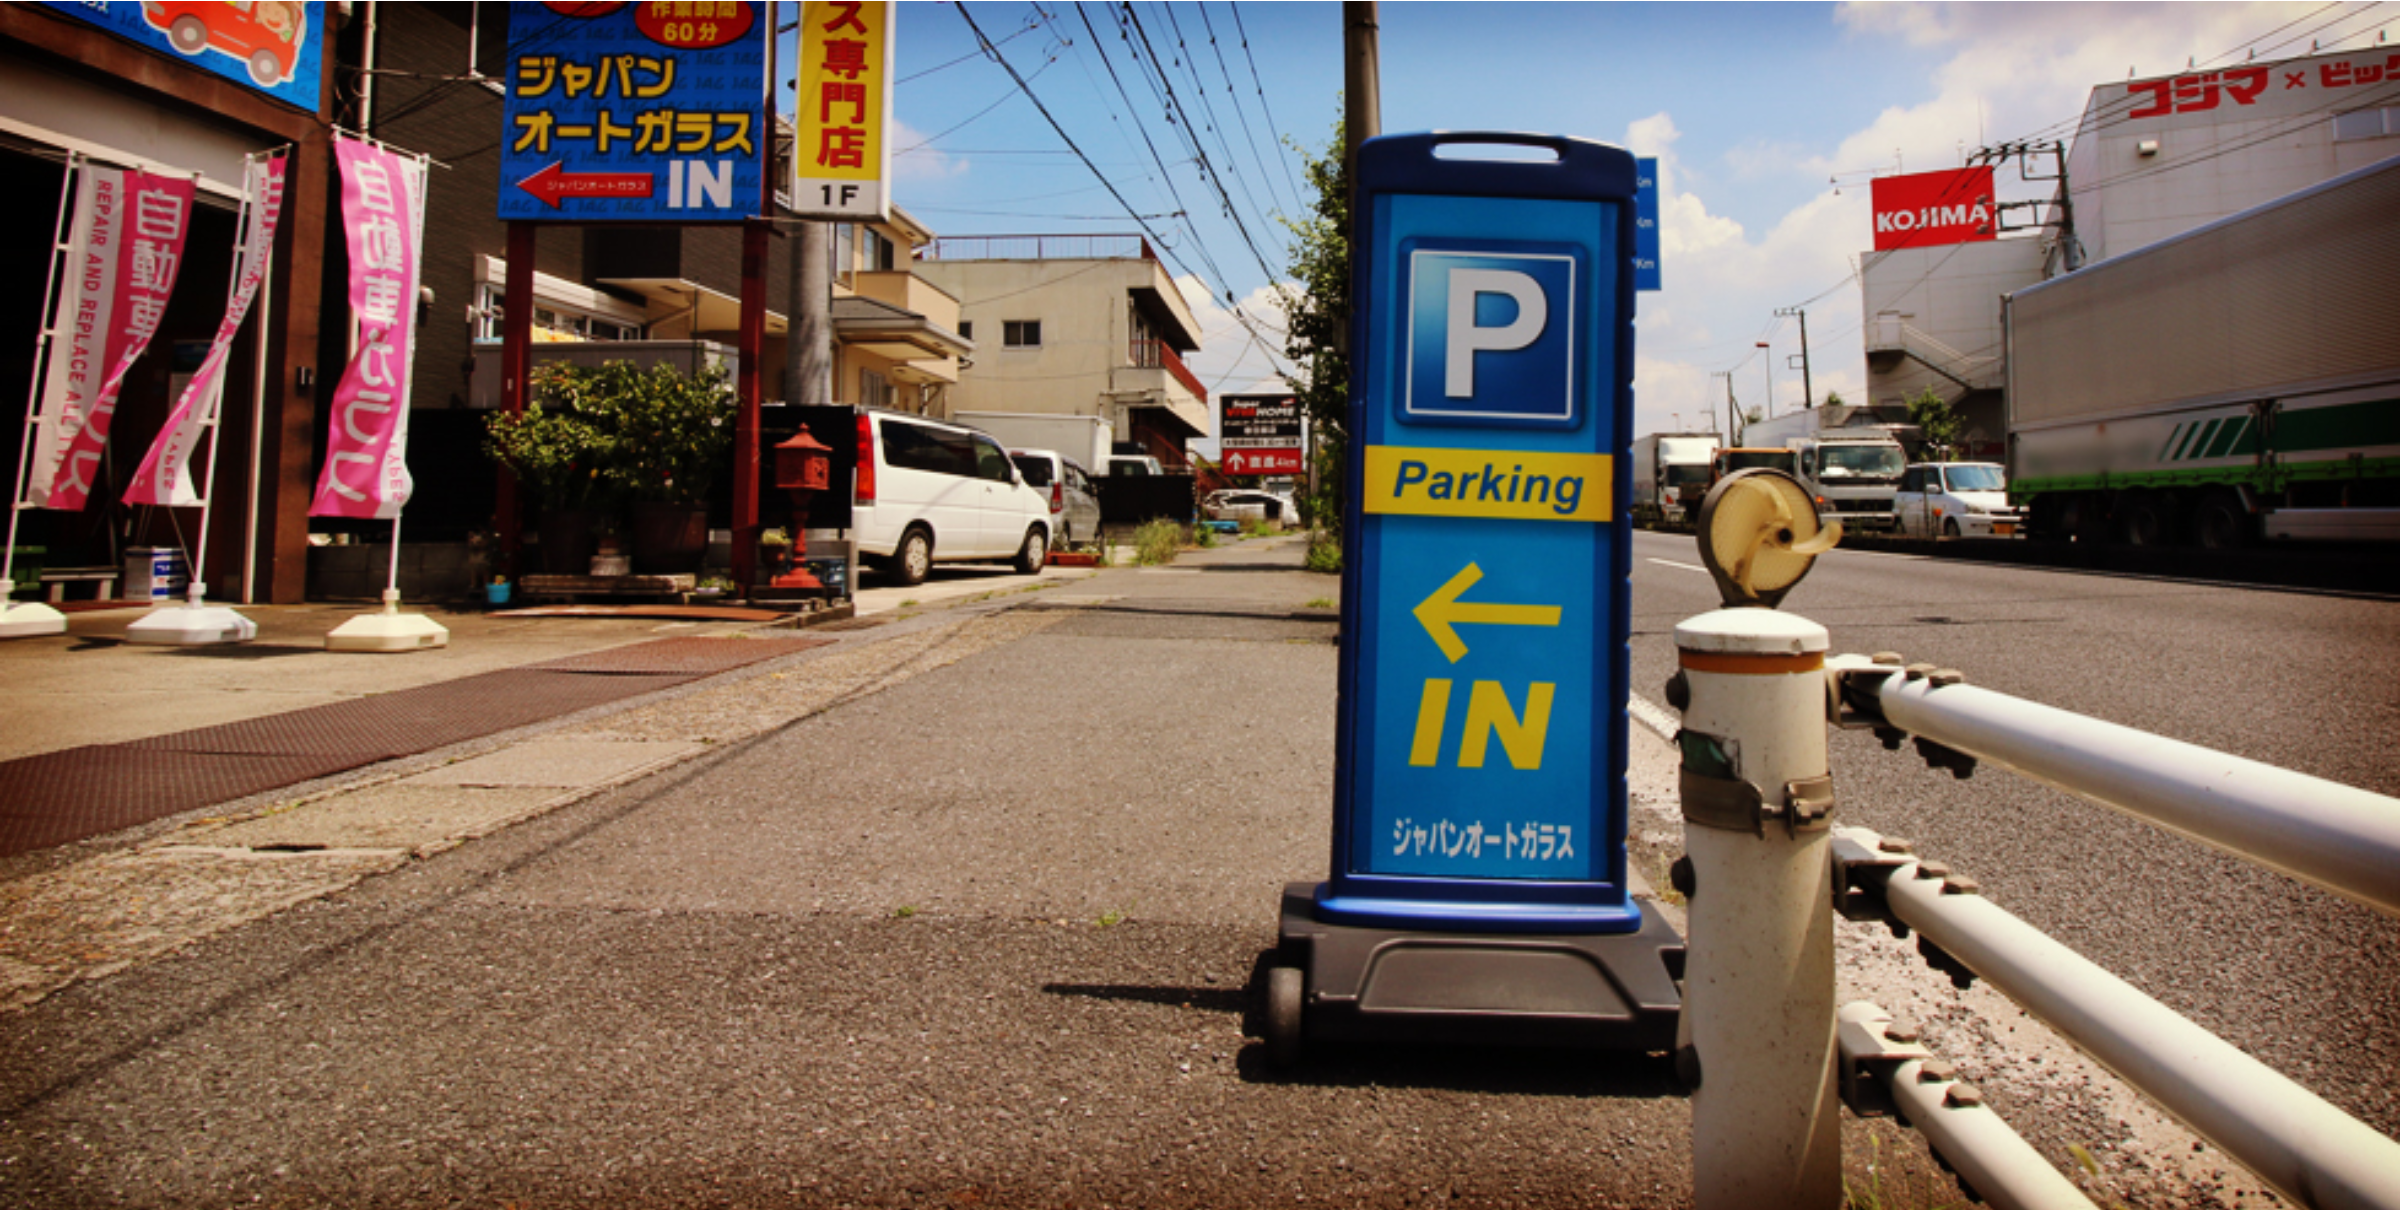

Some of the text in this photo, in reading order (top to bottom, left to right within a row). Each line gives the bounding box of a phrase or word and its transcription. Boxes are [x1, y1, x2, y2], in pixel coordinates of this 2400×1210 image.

[515, 55, 676, 97] ジャパン
[2128, 66, 2268, 118] コジマ
[513, 110, 753, 154] オートガラス
[667, 160, 734, 208] IN
[89, 178, 113, 246] REPAIR
[1877, 203, 1989, 232] KOJIMA
[82, 254, 104, 292] AND
[66, 299, 98, 384] REPLACE
[1445, 267, 1548, 398] P
[1393, 459, 1585, 516] Parking
[1408, 677, 1557, 771] IN
[1392, 817, 1575, 861] ジャパンオートガラス
